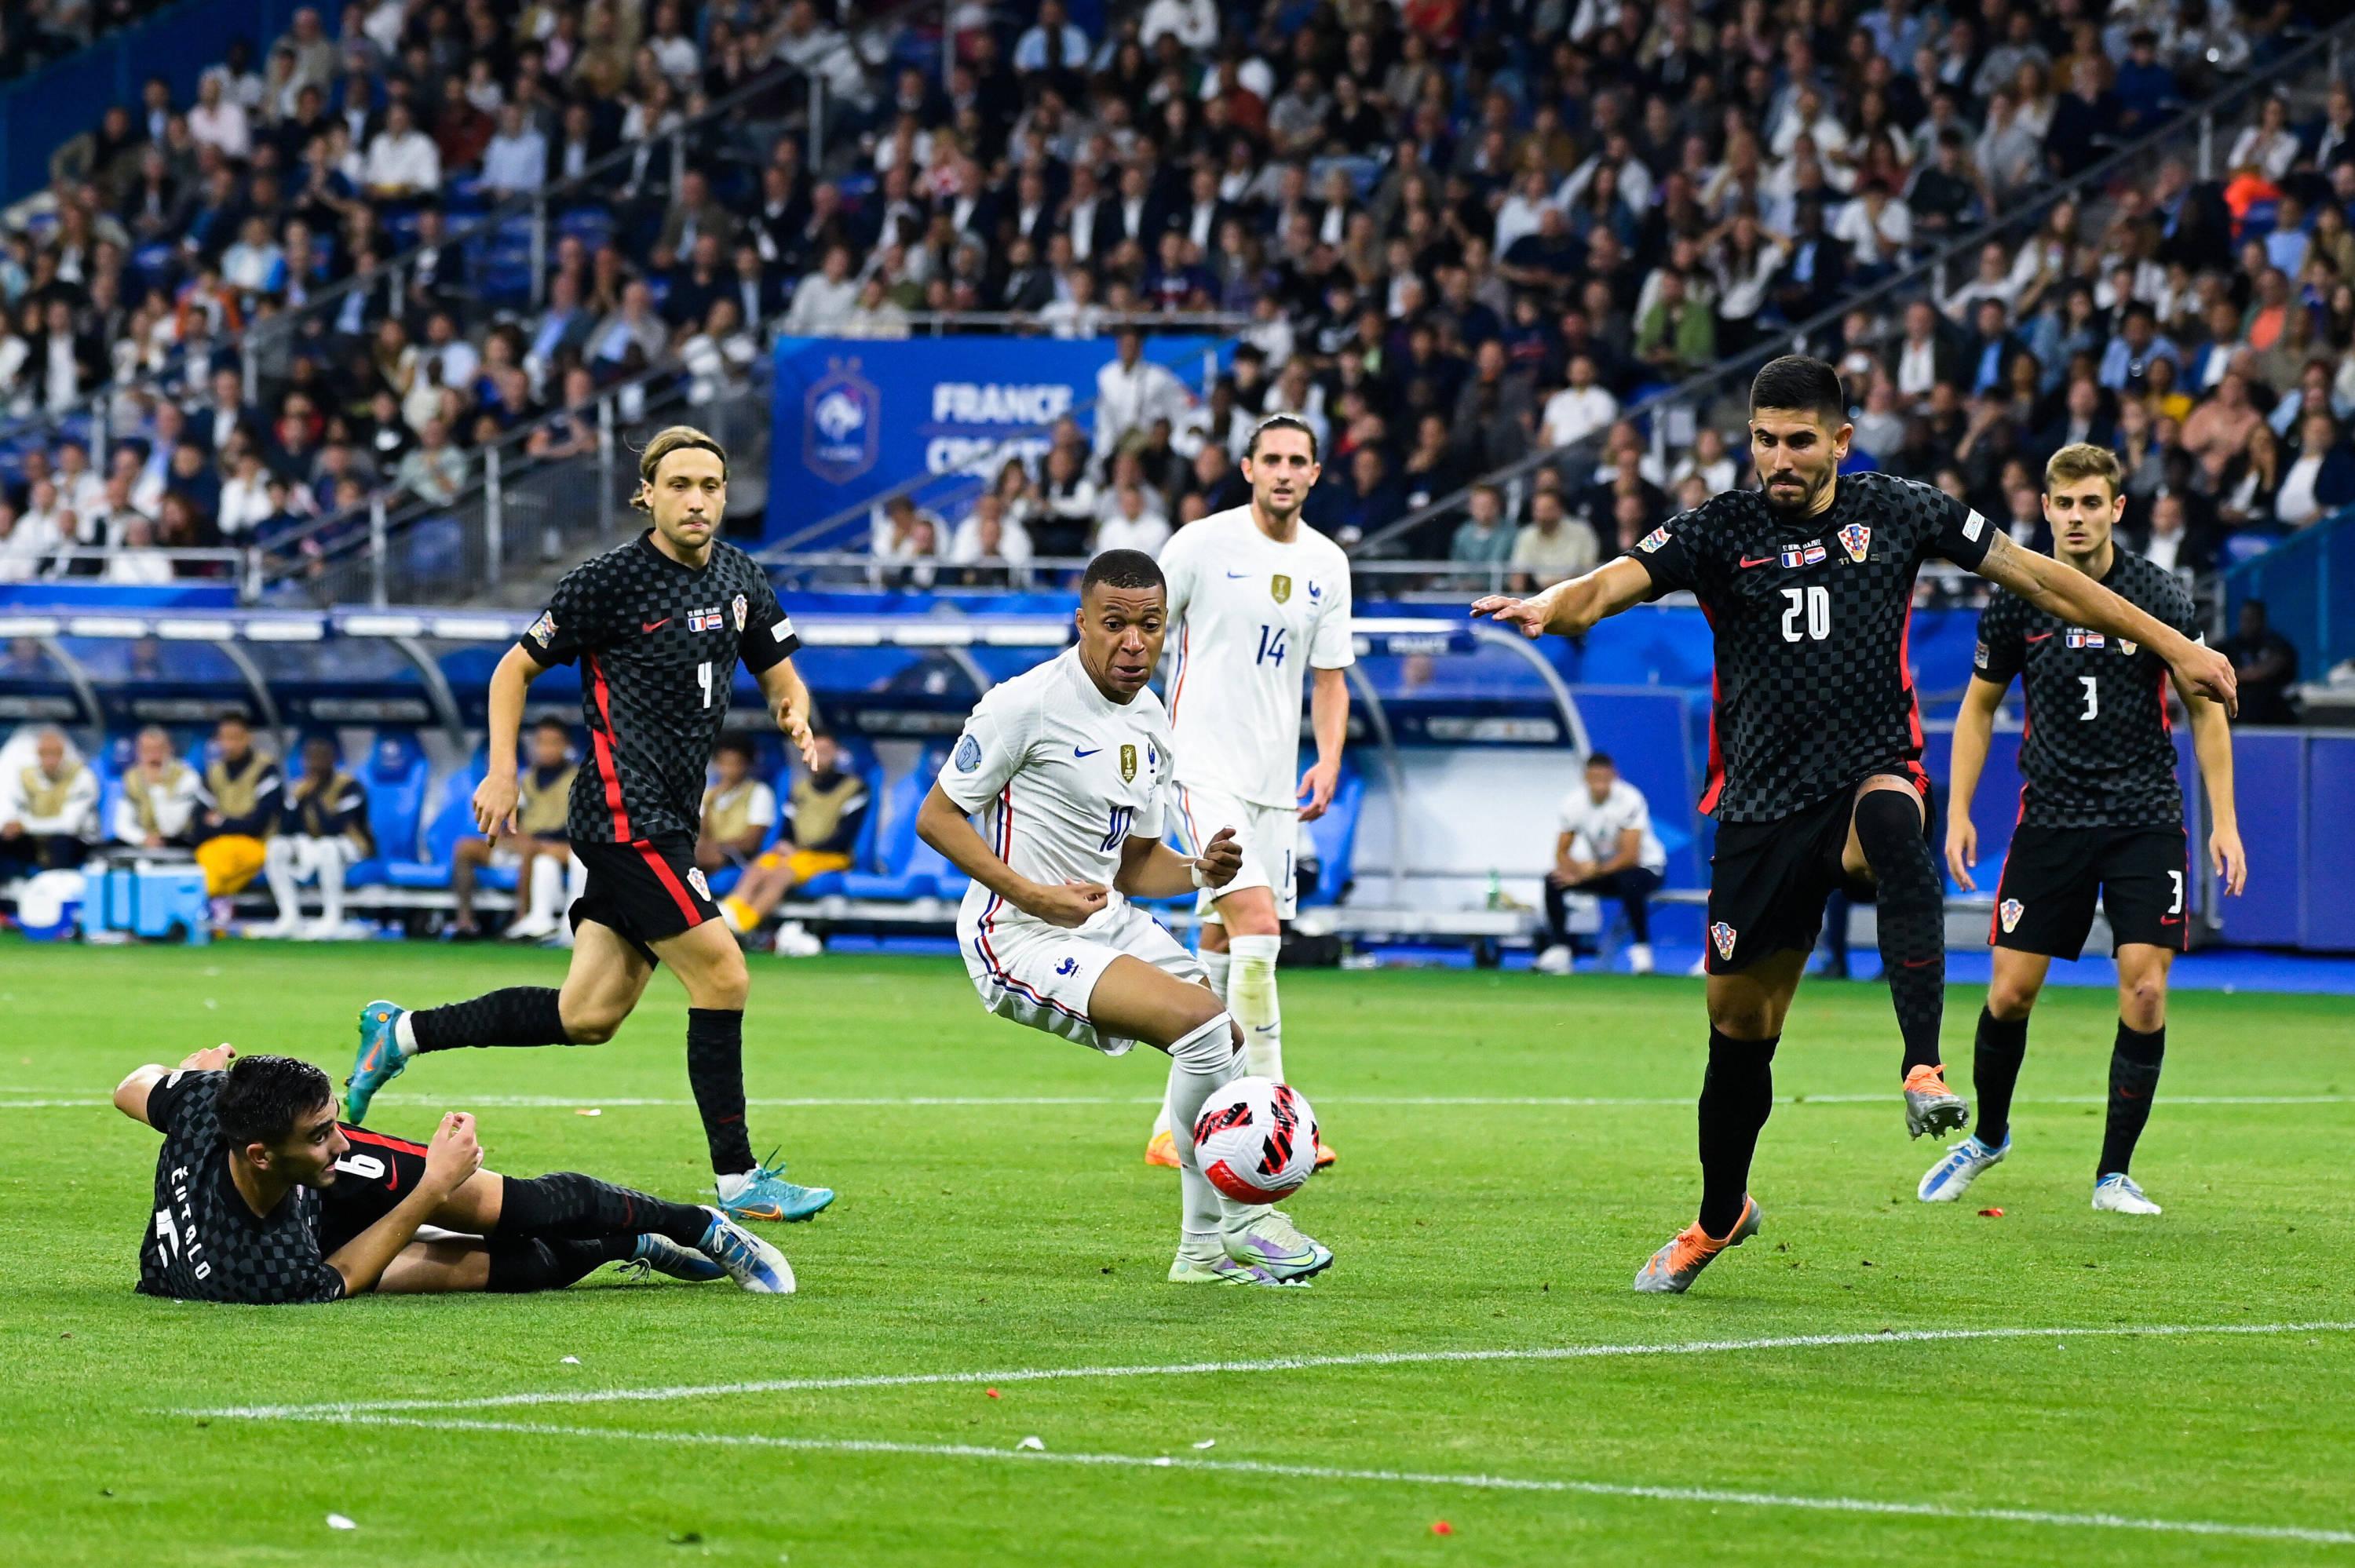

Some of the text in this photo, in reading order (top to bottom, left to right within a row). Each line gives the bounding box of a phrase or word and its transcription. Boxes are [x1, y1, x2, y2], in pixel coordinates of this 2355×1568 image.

[932, 381, 1073, 425] FRANCE
[1780, 586, 1830, 642] 20
[1256, 625, 1286, 667] 14
[698, 662, 713, 709] 4
[2079, 676, 2098, 720] 3
[1099, 806, 1134, 852] 10
[1285, 849, 1296, 888] 1
[2167, 870, 2183, 914] 3
[334, 1152, 385, 1180] 6
